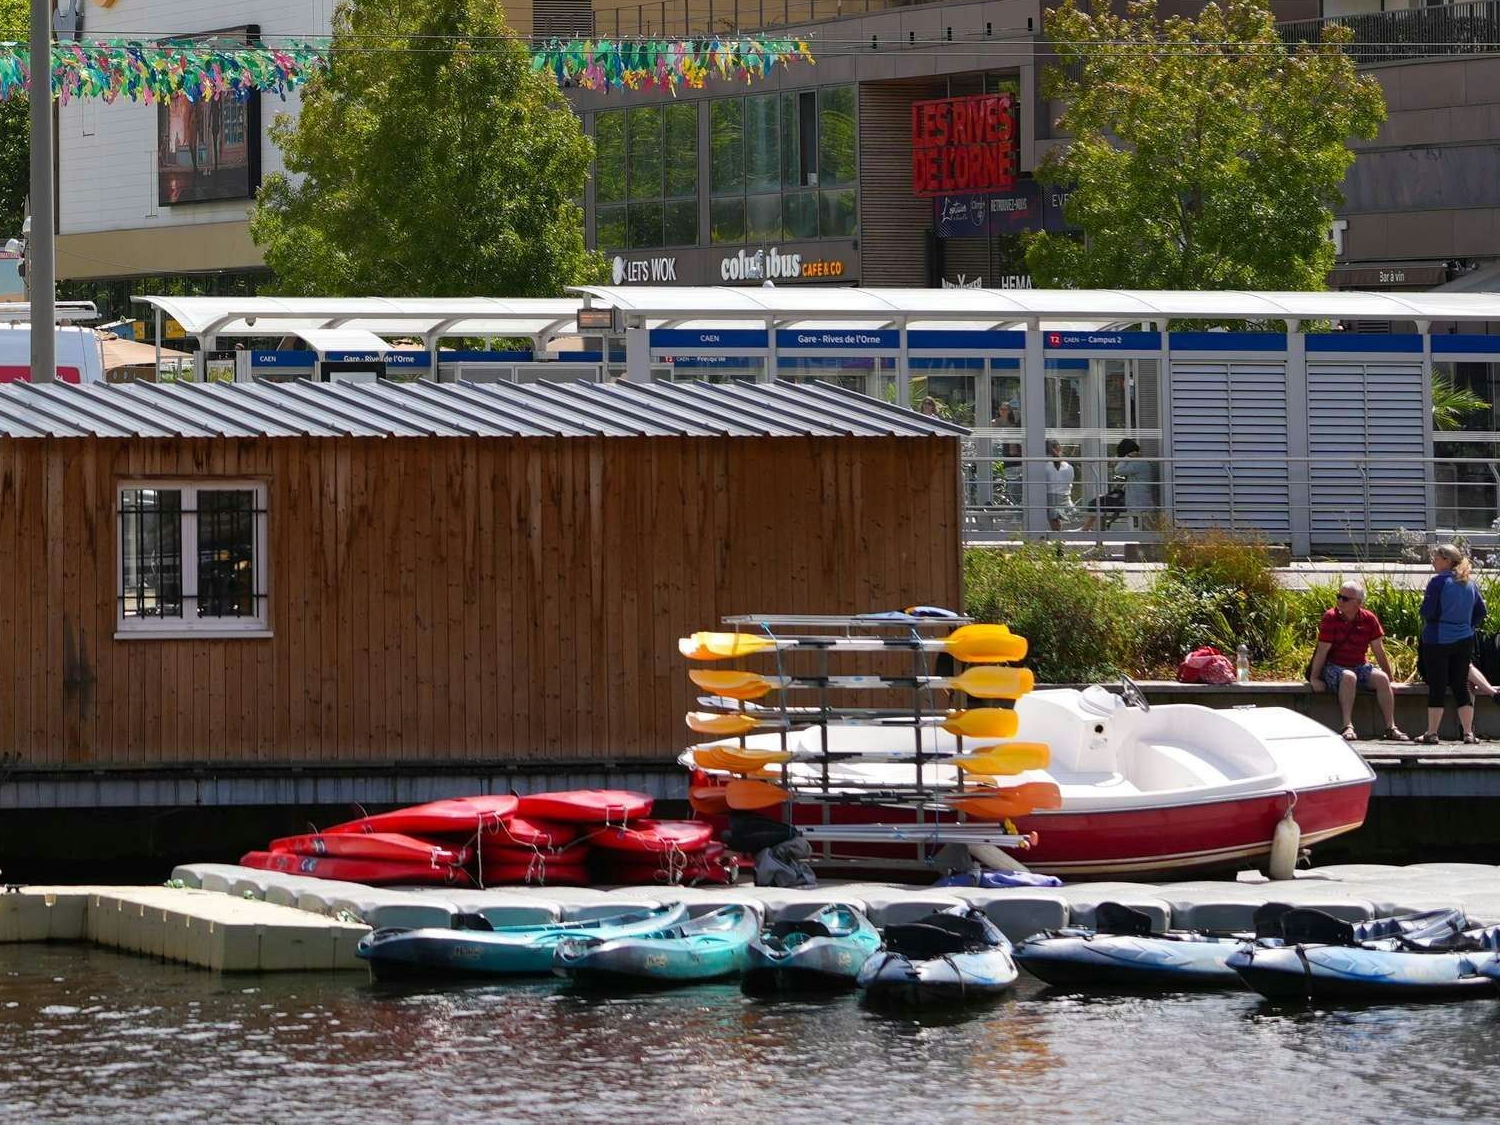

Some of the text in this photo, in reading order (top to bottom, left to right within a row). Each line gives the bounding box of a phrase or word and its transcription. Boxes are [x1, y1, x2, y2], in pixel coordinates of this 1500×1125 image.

[912, 96, 1013, 147] LES RIVES
[914, 142, 1013, 191] DE L'ORNE
[651, 257, 677, 281] WOK
[699, 335, 720, 343] CAEN
[797, 334, 816, 344] Gare
[822, 334, 844, 344] Rives
[856, 334, 881, 344] l'Orne
[1088, 336, 1116, 345] Campus
[259, 355, 277, 363] CAEN
[343, 355, 360, 363] Gare
[393, 354, 415, 363] l'Orne
